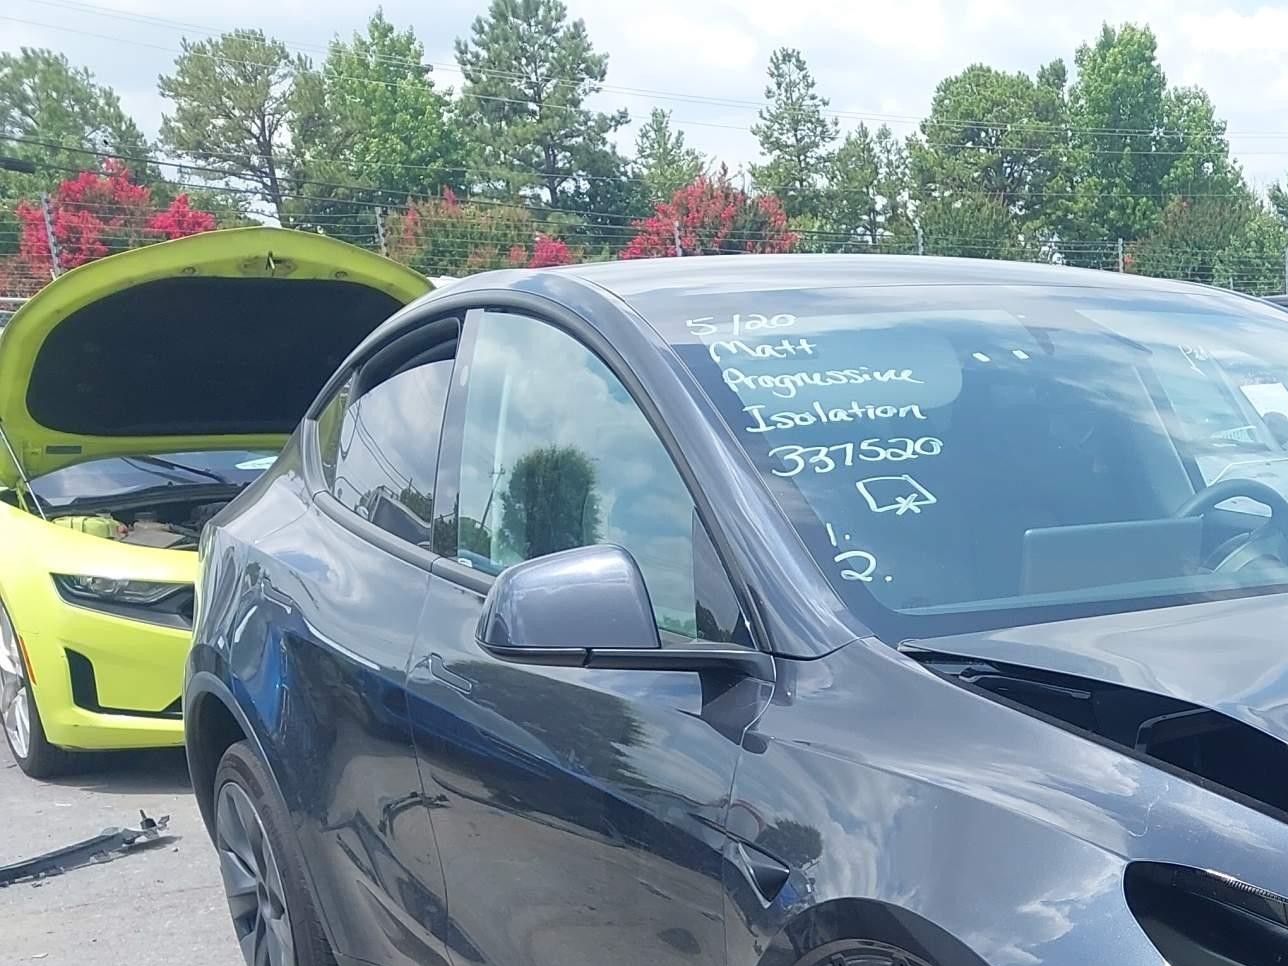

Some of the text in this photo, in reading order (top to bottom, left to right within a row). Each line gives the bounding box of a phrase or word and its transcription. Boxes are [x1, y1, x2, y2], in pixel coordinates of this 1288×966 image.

[709, 338, 817, 363] Matt
[722, 366, 924, 398] Progressive
[743, 401, 927, 433] Isolation
[769, 437, 943, 477] 337520
[834, 550, 893, 583] 2.
